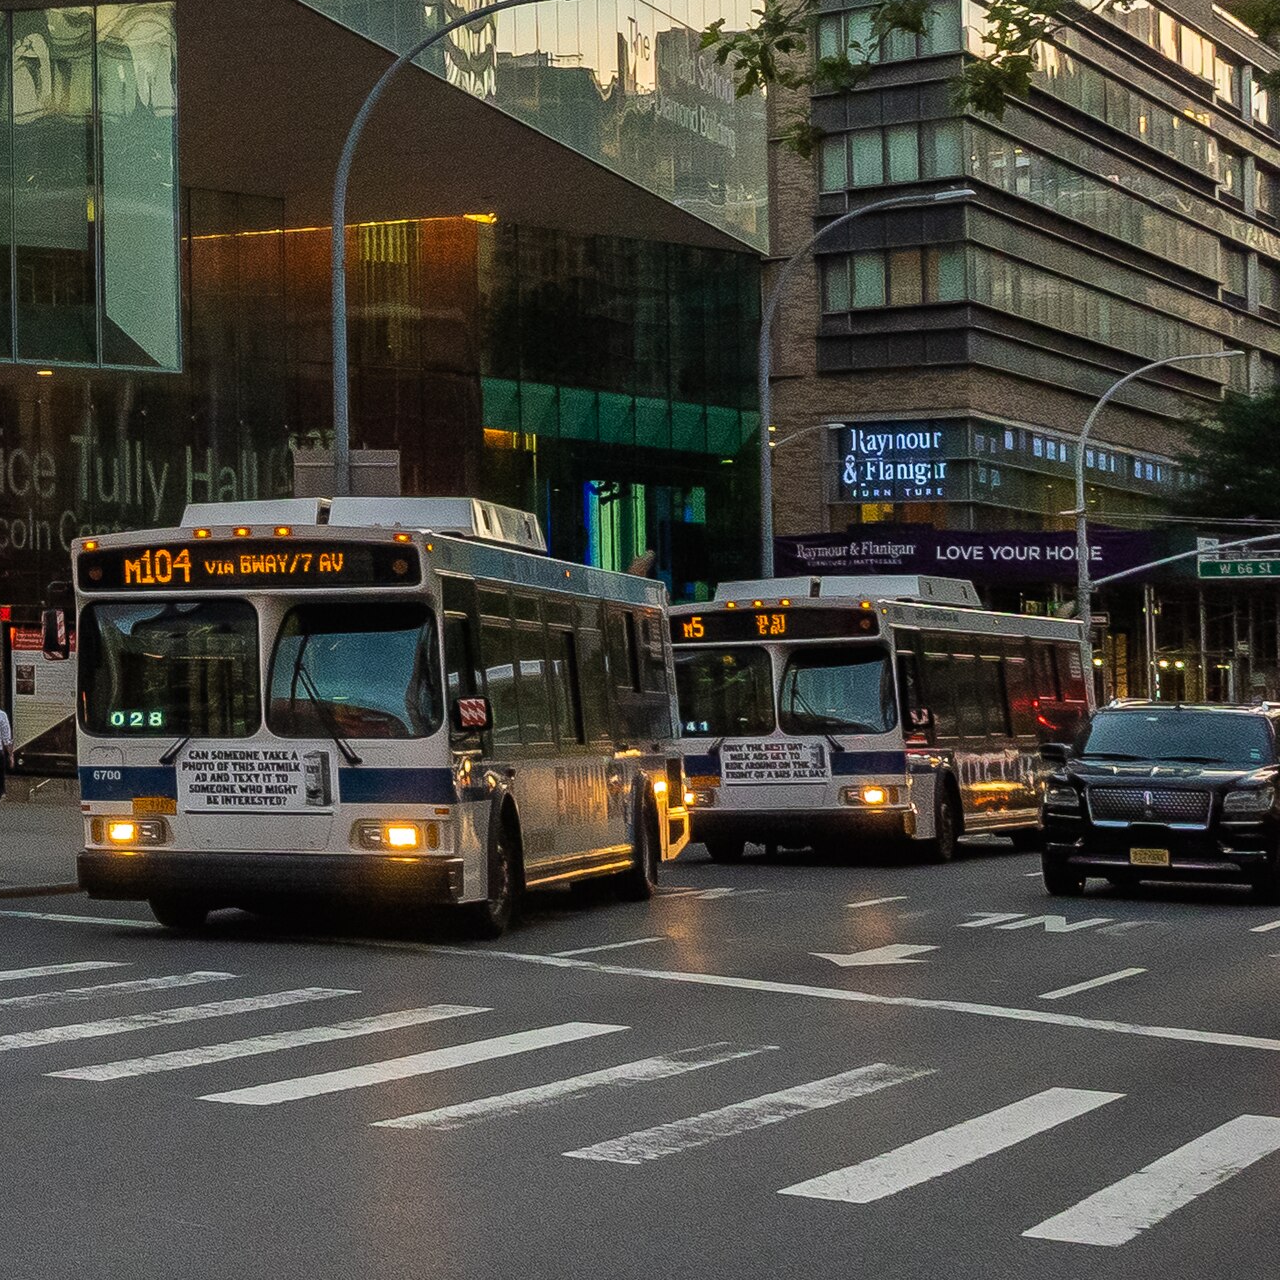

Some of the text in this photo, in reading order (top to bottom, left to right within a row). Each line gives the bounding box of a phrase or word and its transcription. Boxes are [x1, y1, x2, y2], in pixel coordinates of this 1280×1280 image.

[843, 454, 857, 484] &
[70, 434, 169, 522] Tully
[186, 444, 259, 503] Hall
[796, 541, 916, 560] Raymour & Flanigan
[936, 546, 984, 560] LOVE
[989, 546, 1040, 560] YOUR
[125, 549, 344, 583] M104 VIA BWAY/7 AV
[1220, 562, 1272, 574] W 66 St
[683, 616, 704, 638] M5
[188, 750, 299, 760] CAN SOMEONE TAKE A
[788, 752, 800, 760] TO
[182, 762, 215, 771] PHOTO
[217, 762, 229, 771] OF
[231, 762, 255, 771] THIS
[258, 762, 301, 772] OATMILK
[93, 770, 121, 780] 6700
[195, 773, 289, 783] AD AND TEXT IT TO
[189, 784, 298, 795] SOMEONE WHO MIGHT
[206, 795, 288, 806] BE INTERESTED?
